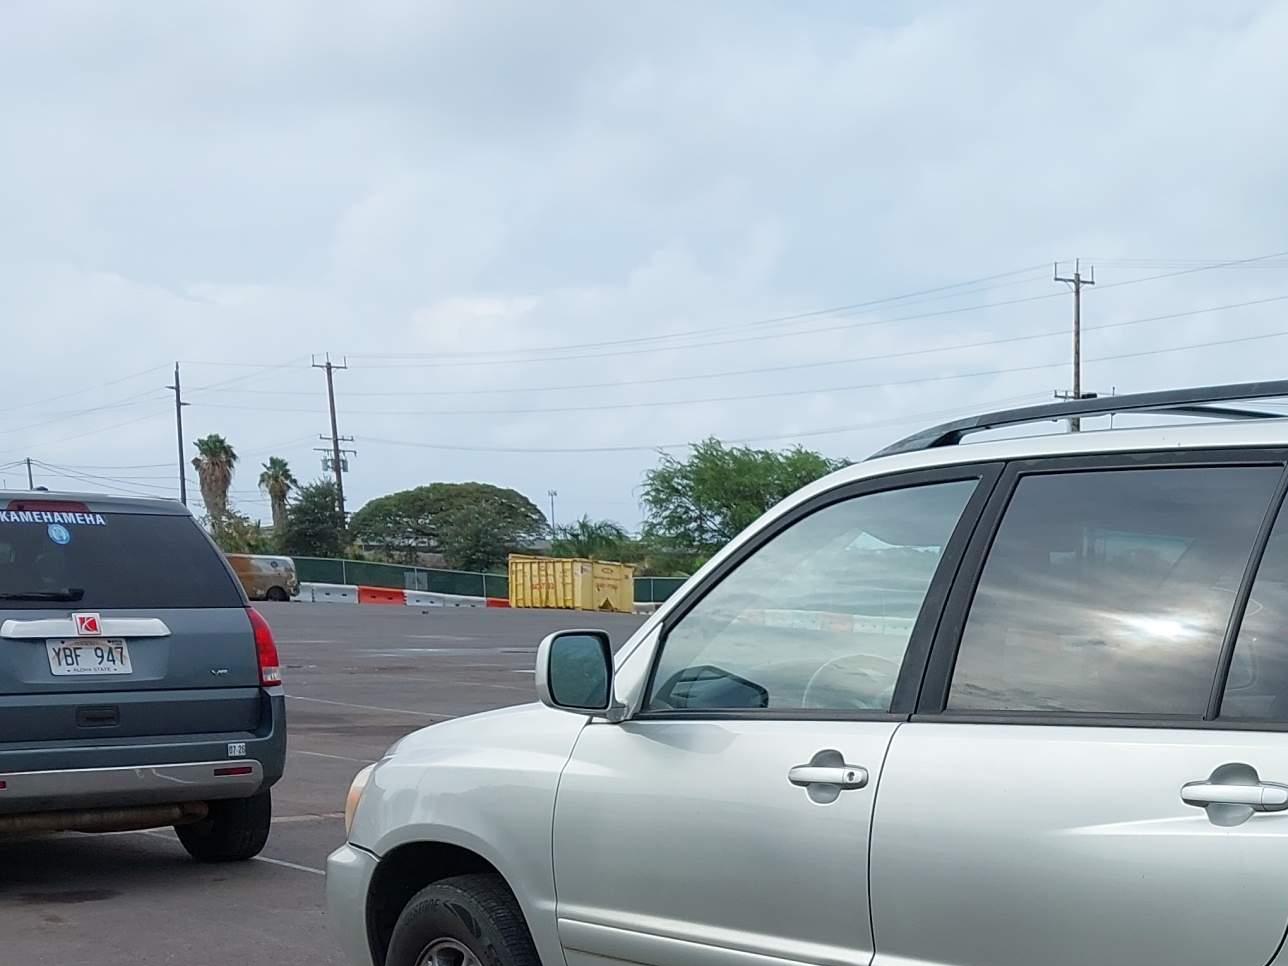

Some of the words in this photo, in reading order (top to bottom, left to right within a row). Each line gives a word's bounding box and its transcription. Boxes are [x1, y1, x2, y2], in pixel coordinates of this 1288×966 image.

[0, 511, 106, 525] KAMEHAMEHA
[52, 647, 82, 666] YBF
[94, 646, 124, 665] 947
